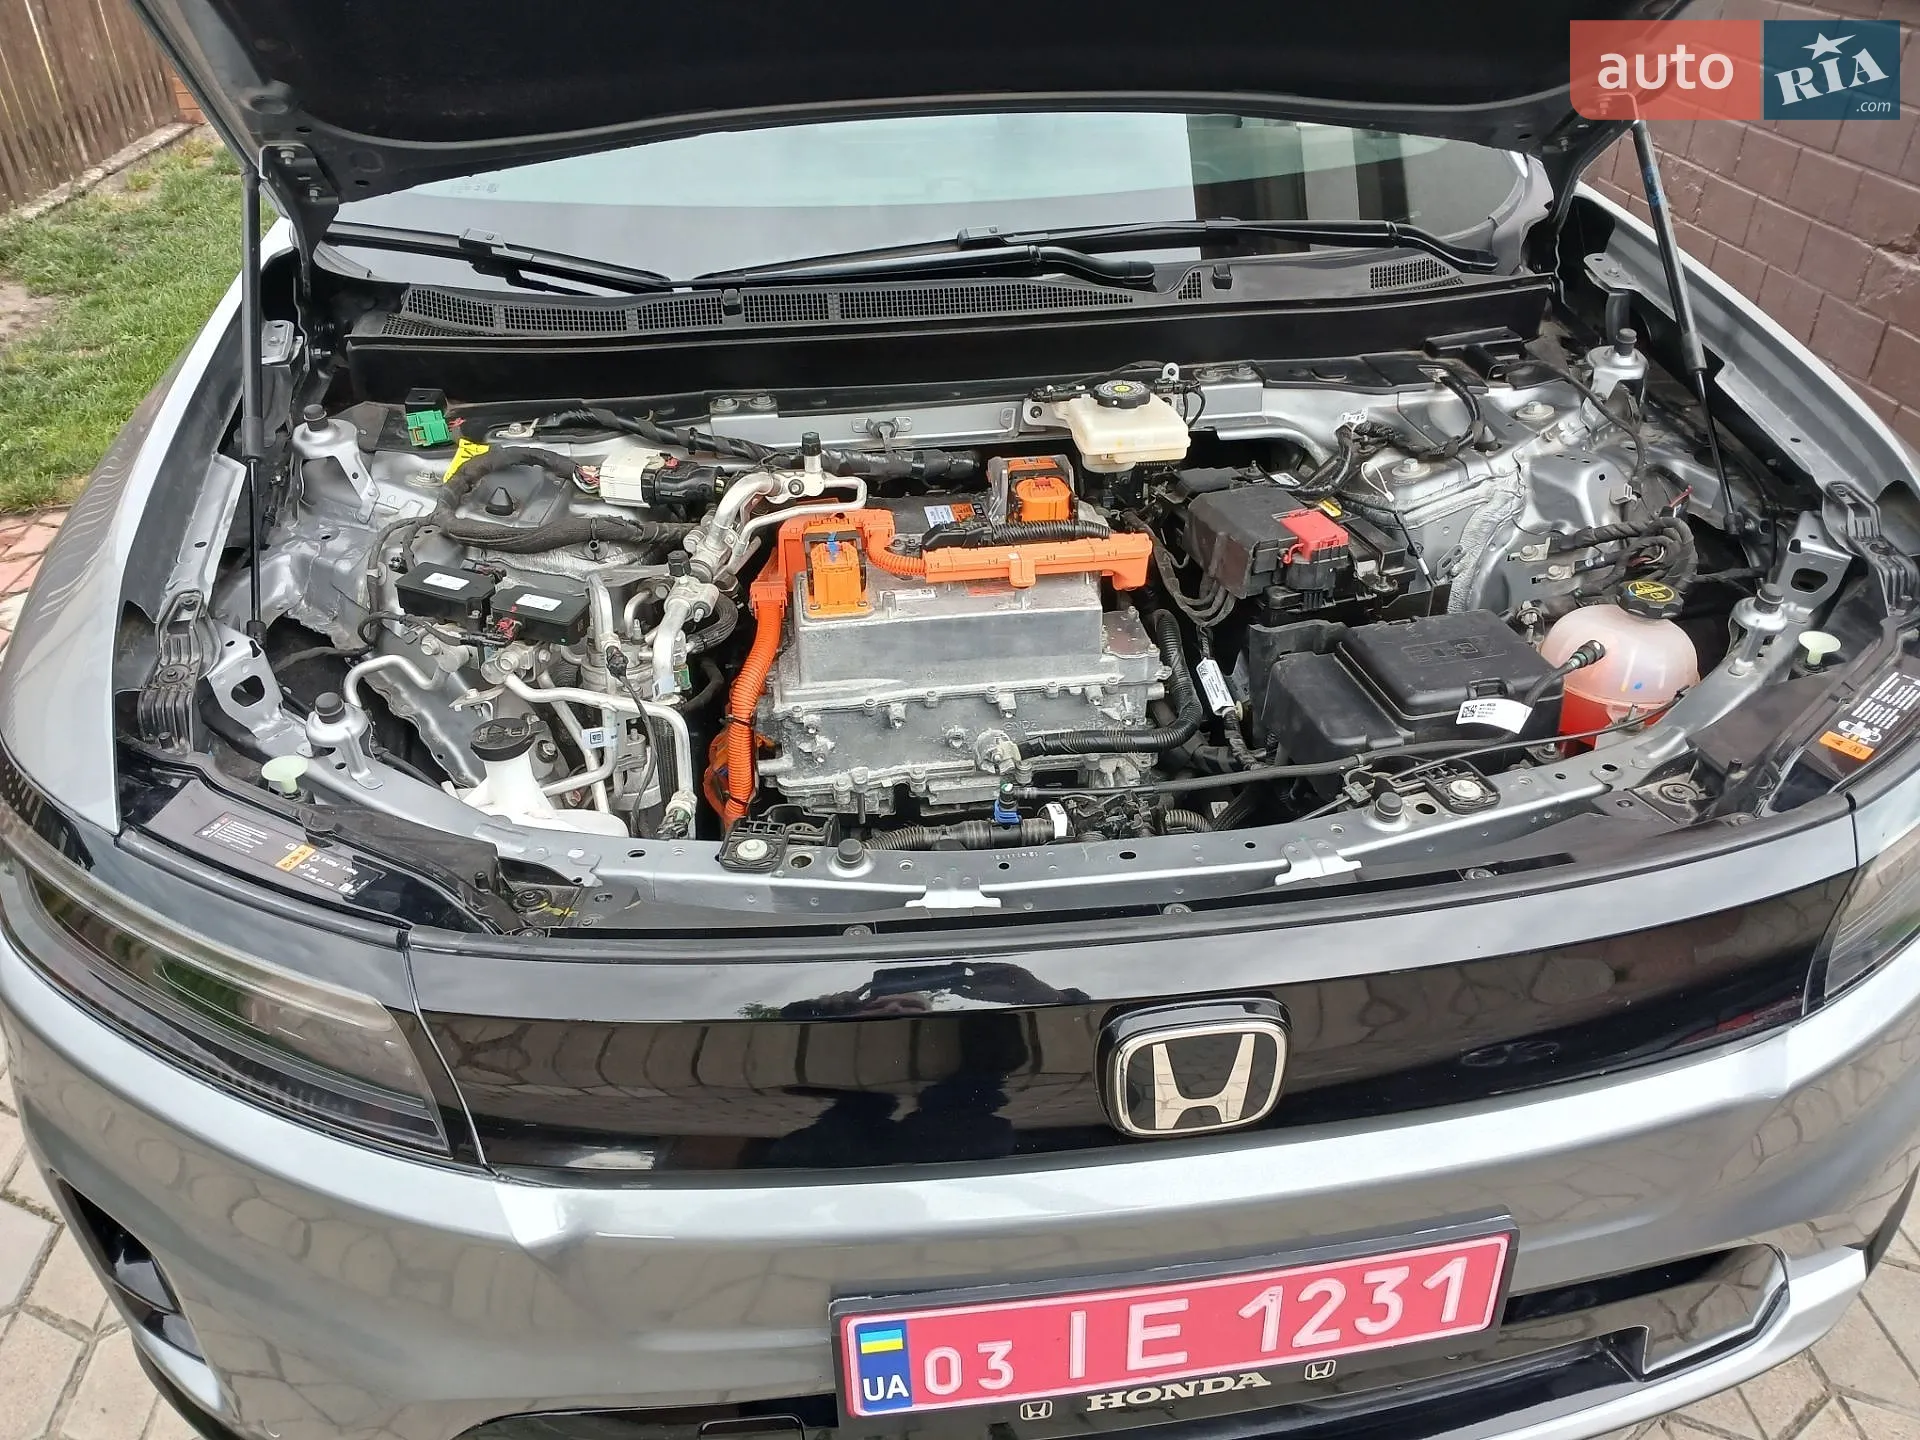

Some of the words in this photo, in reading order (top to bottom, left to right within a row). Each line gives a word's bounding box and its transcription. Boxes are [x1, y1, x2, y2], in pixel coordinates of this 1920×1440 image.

[924, 1340, 1014, 1397] 03
[1237, 1256, 1468, 1354] 1231
[862, 1374, 909, 1403] UA
[1087, 1371, 1272, 1413] HONDA
